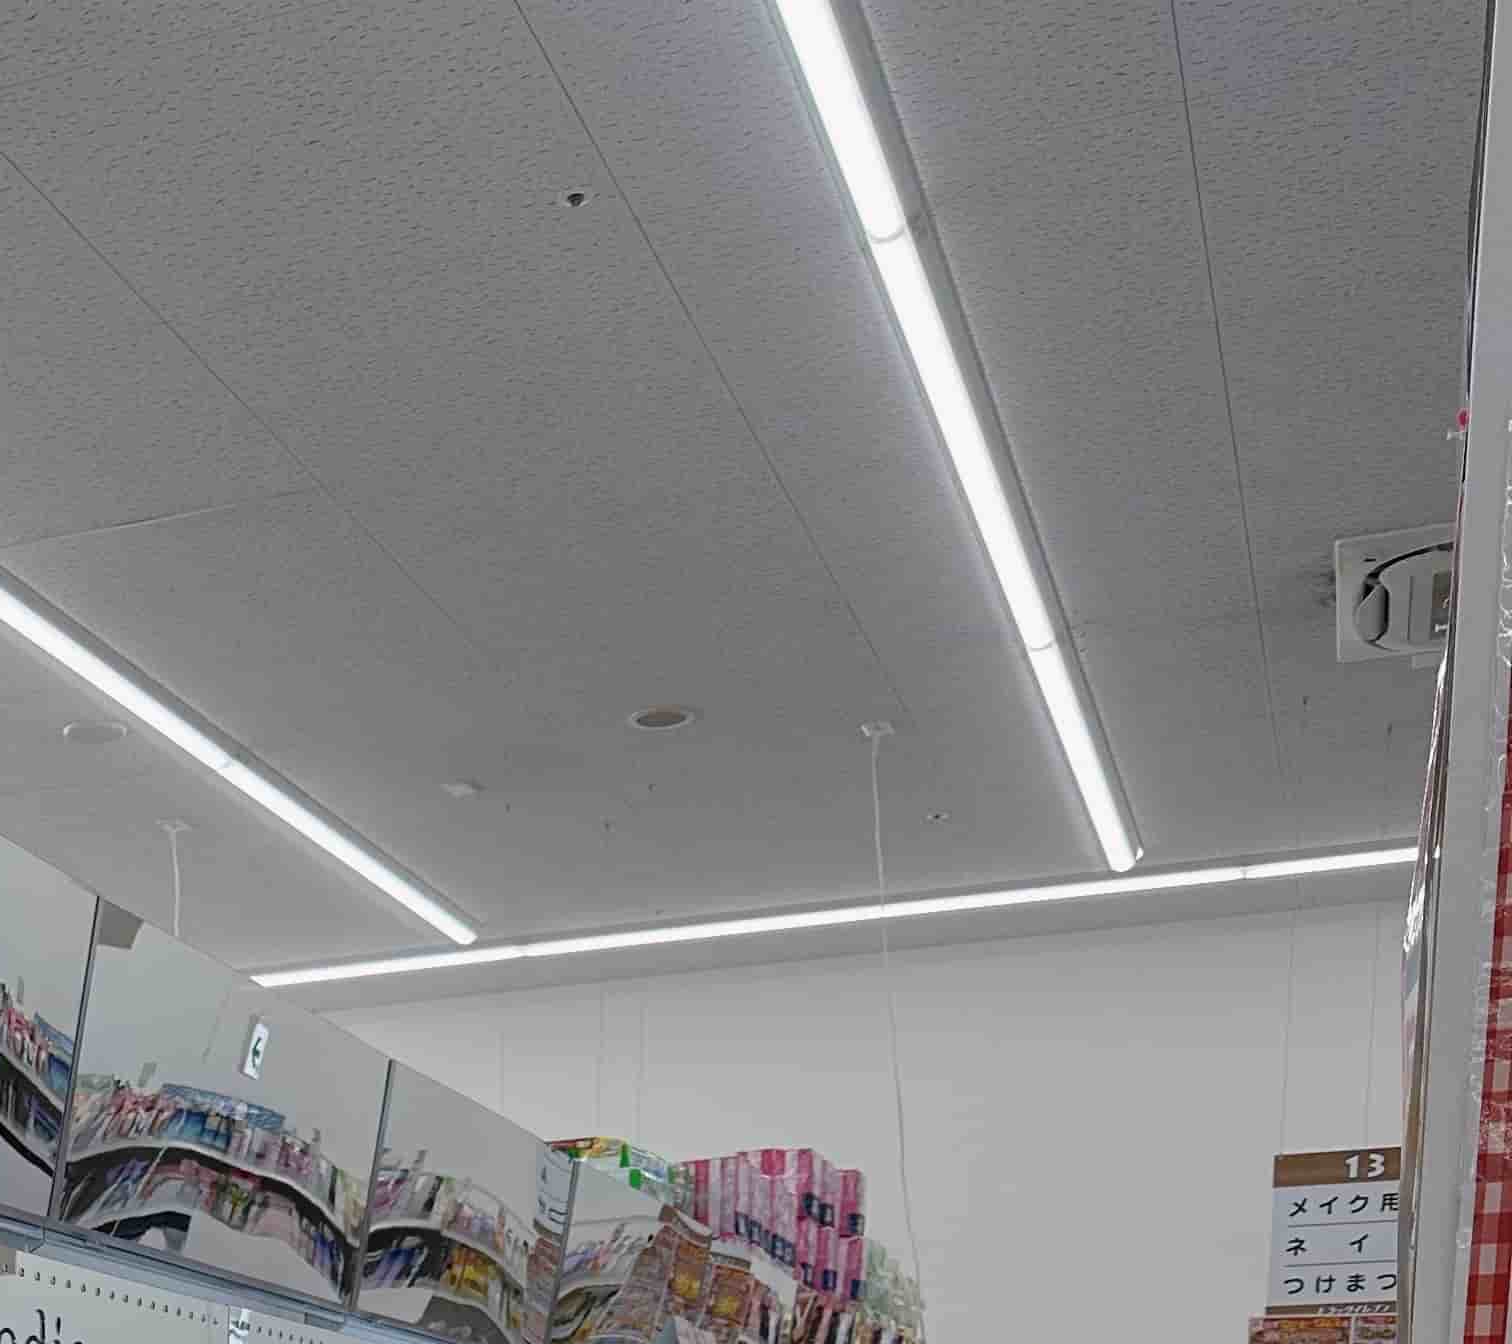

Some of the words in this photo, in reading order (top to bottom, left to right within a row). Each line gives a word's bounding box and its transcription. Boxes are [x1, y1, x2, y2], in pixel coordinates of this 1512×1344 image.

[1343, 1153, 1386, 1179] 13
[1282, 1273, 1399, 1296] つけまつ
